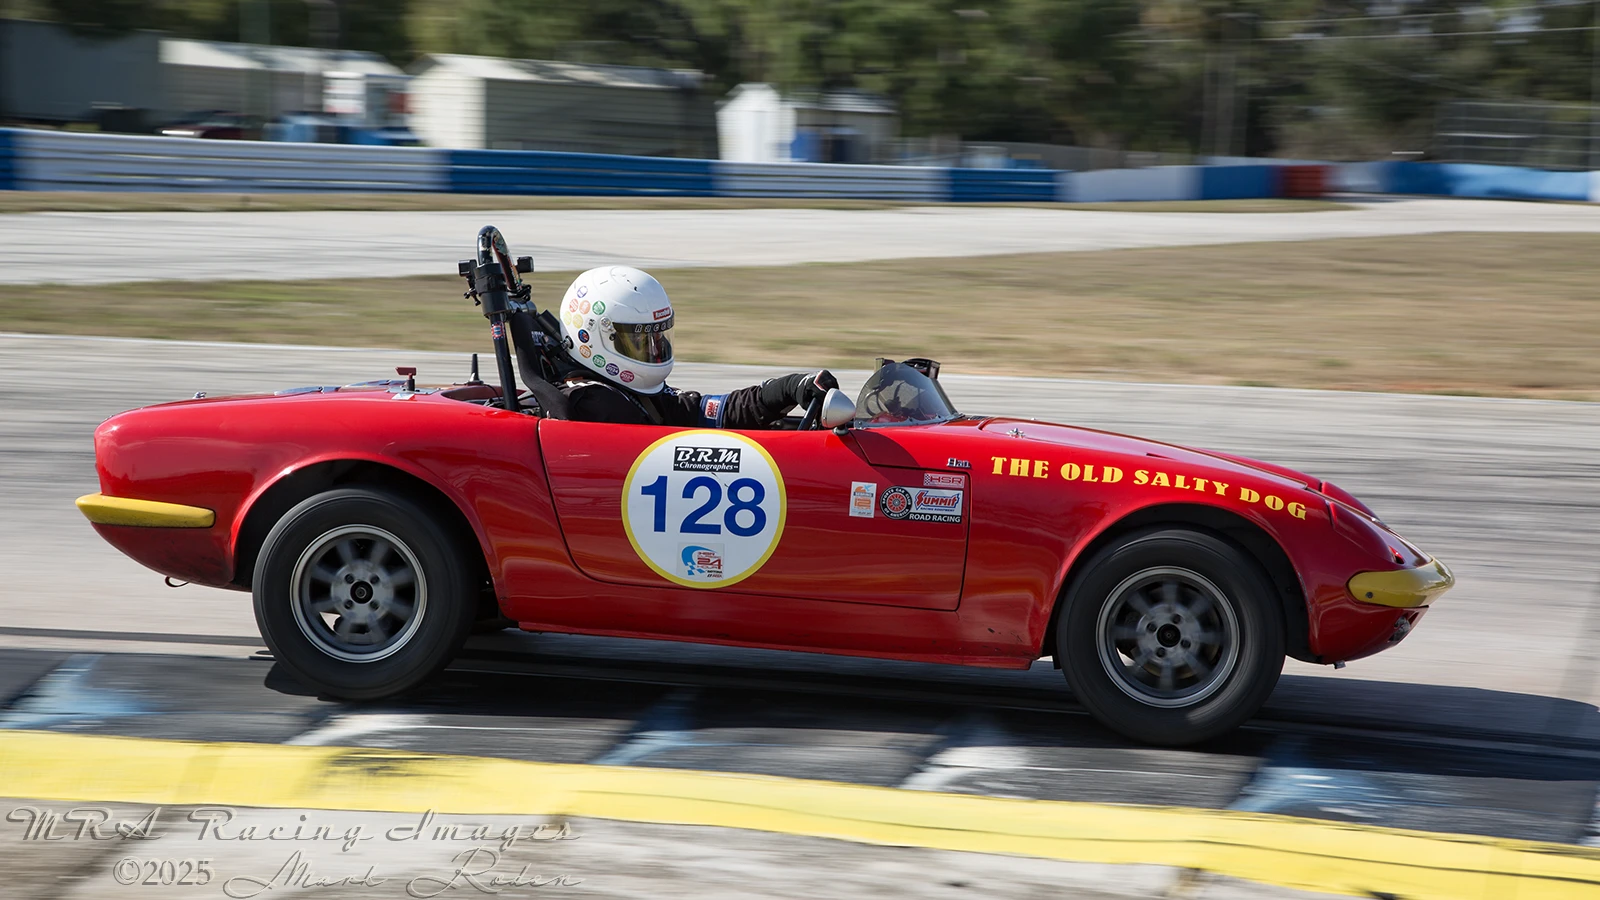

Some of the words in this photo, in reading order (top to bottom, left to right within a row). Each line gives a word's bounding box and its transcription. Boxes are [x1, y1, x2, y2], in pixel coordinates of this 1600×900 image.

[676, 447, 739, 463] B.R.M
[680, 461, 733, 471] Chronographes
[930, 475, 962, 484] HSR
[991, 456, 1049, 479] THE
[1060, 462, 1123, 484] OLD
[1134, 469, 1229, 496] SALTY
[1239, 486, 1306, 520] DOG
[641, 475, 767, 537] 128
[909, 513, 931, 521] ROAD
[932, 515, 961, 523] RACING
[697, 557, 722, 570] 24
